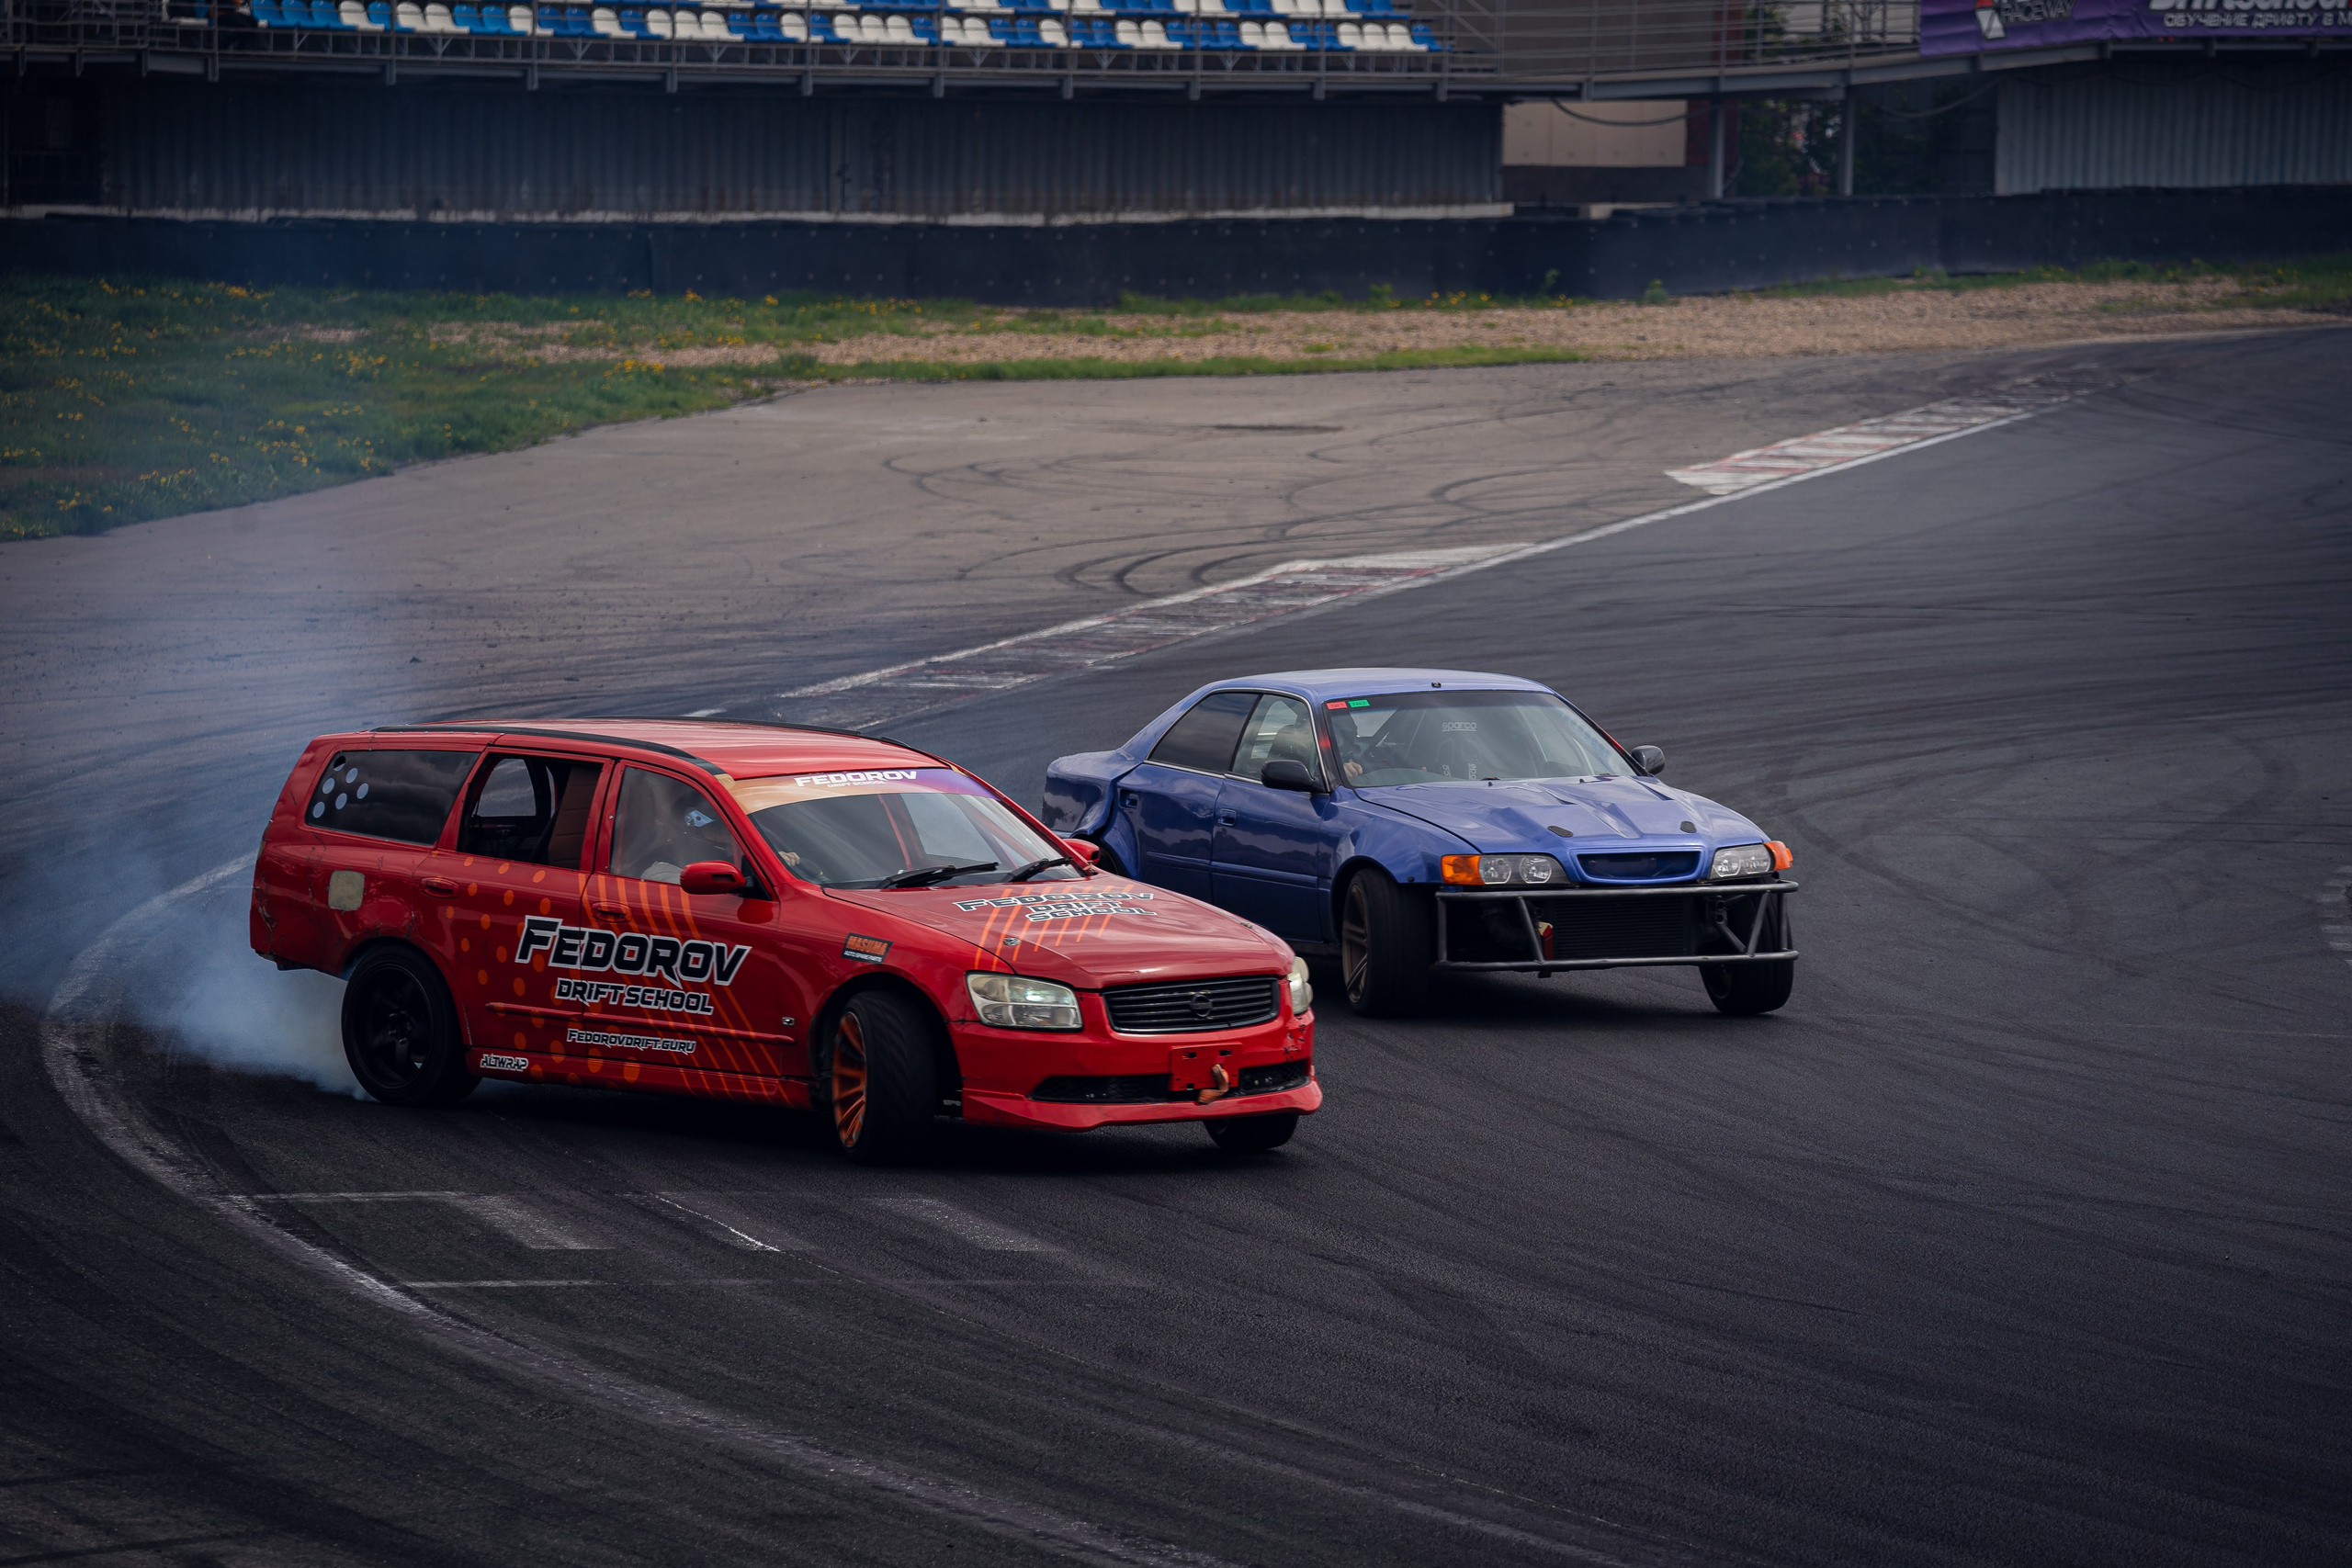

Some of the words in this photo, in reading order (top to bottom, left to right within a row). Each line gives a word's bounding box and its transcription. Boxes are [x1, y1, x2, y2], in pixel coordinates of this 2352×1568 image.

[2001, 0, 2075, 23] RACEWAY
[2164, 12, 2249, 28] ОБУЧЕНИЕ
[1442, 721, 1477, 732] sparco
[794, 771, 918, 787] FEDOROV
[952, 893, 1155, 912] FEDOROV
[1026, 900, 1124, 914] DRIFT
[1024, 907, 1158, 922] SCHOOL
[514, 914, 752, 990] FEDOROV
[845, 935, 888, 955] MASUMA
[567, 1028, 696, 1055] FEDOROVDRIFT.GURU
